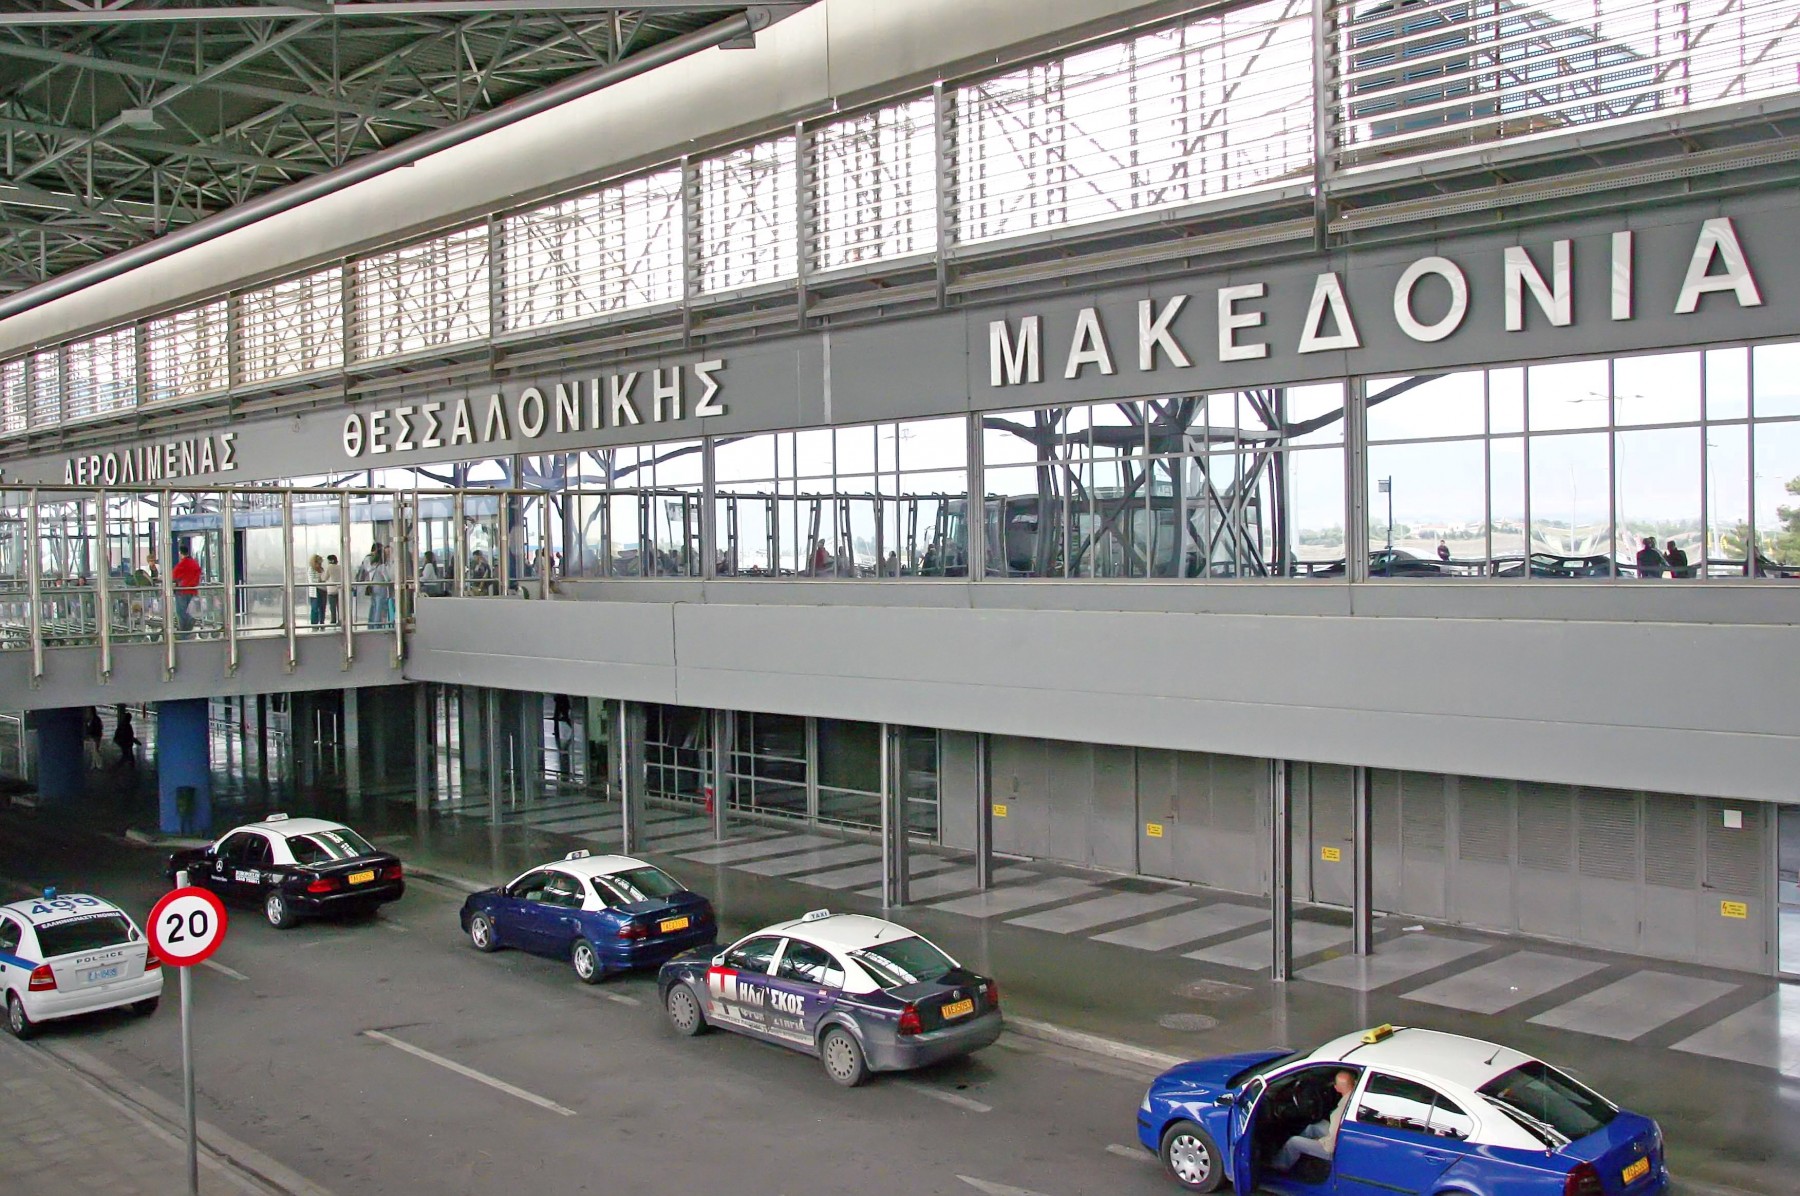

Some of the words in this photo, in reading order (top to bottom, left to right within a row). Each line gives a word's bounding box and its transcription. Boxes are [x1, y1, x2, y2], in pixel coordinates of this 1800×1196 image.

[64, 432, 238, 485] ΑΕΡΟΛΙΜΕΝΑΣ
[343, 359, 727, 457] ΘΕΣΣΑΛΟΝΙΚΗΣ
[989, 217, 1763, 386] ΜΑΚΕΔΟΝΙΑ
[32, 897, 100, 914] 499
[166, 909, 208, 943] 20
